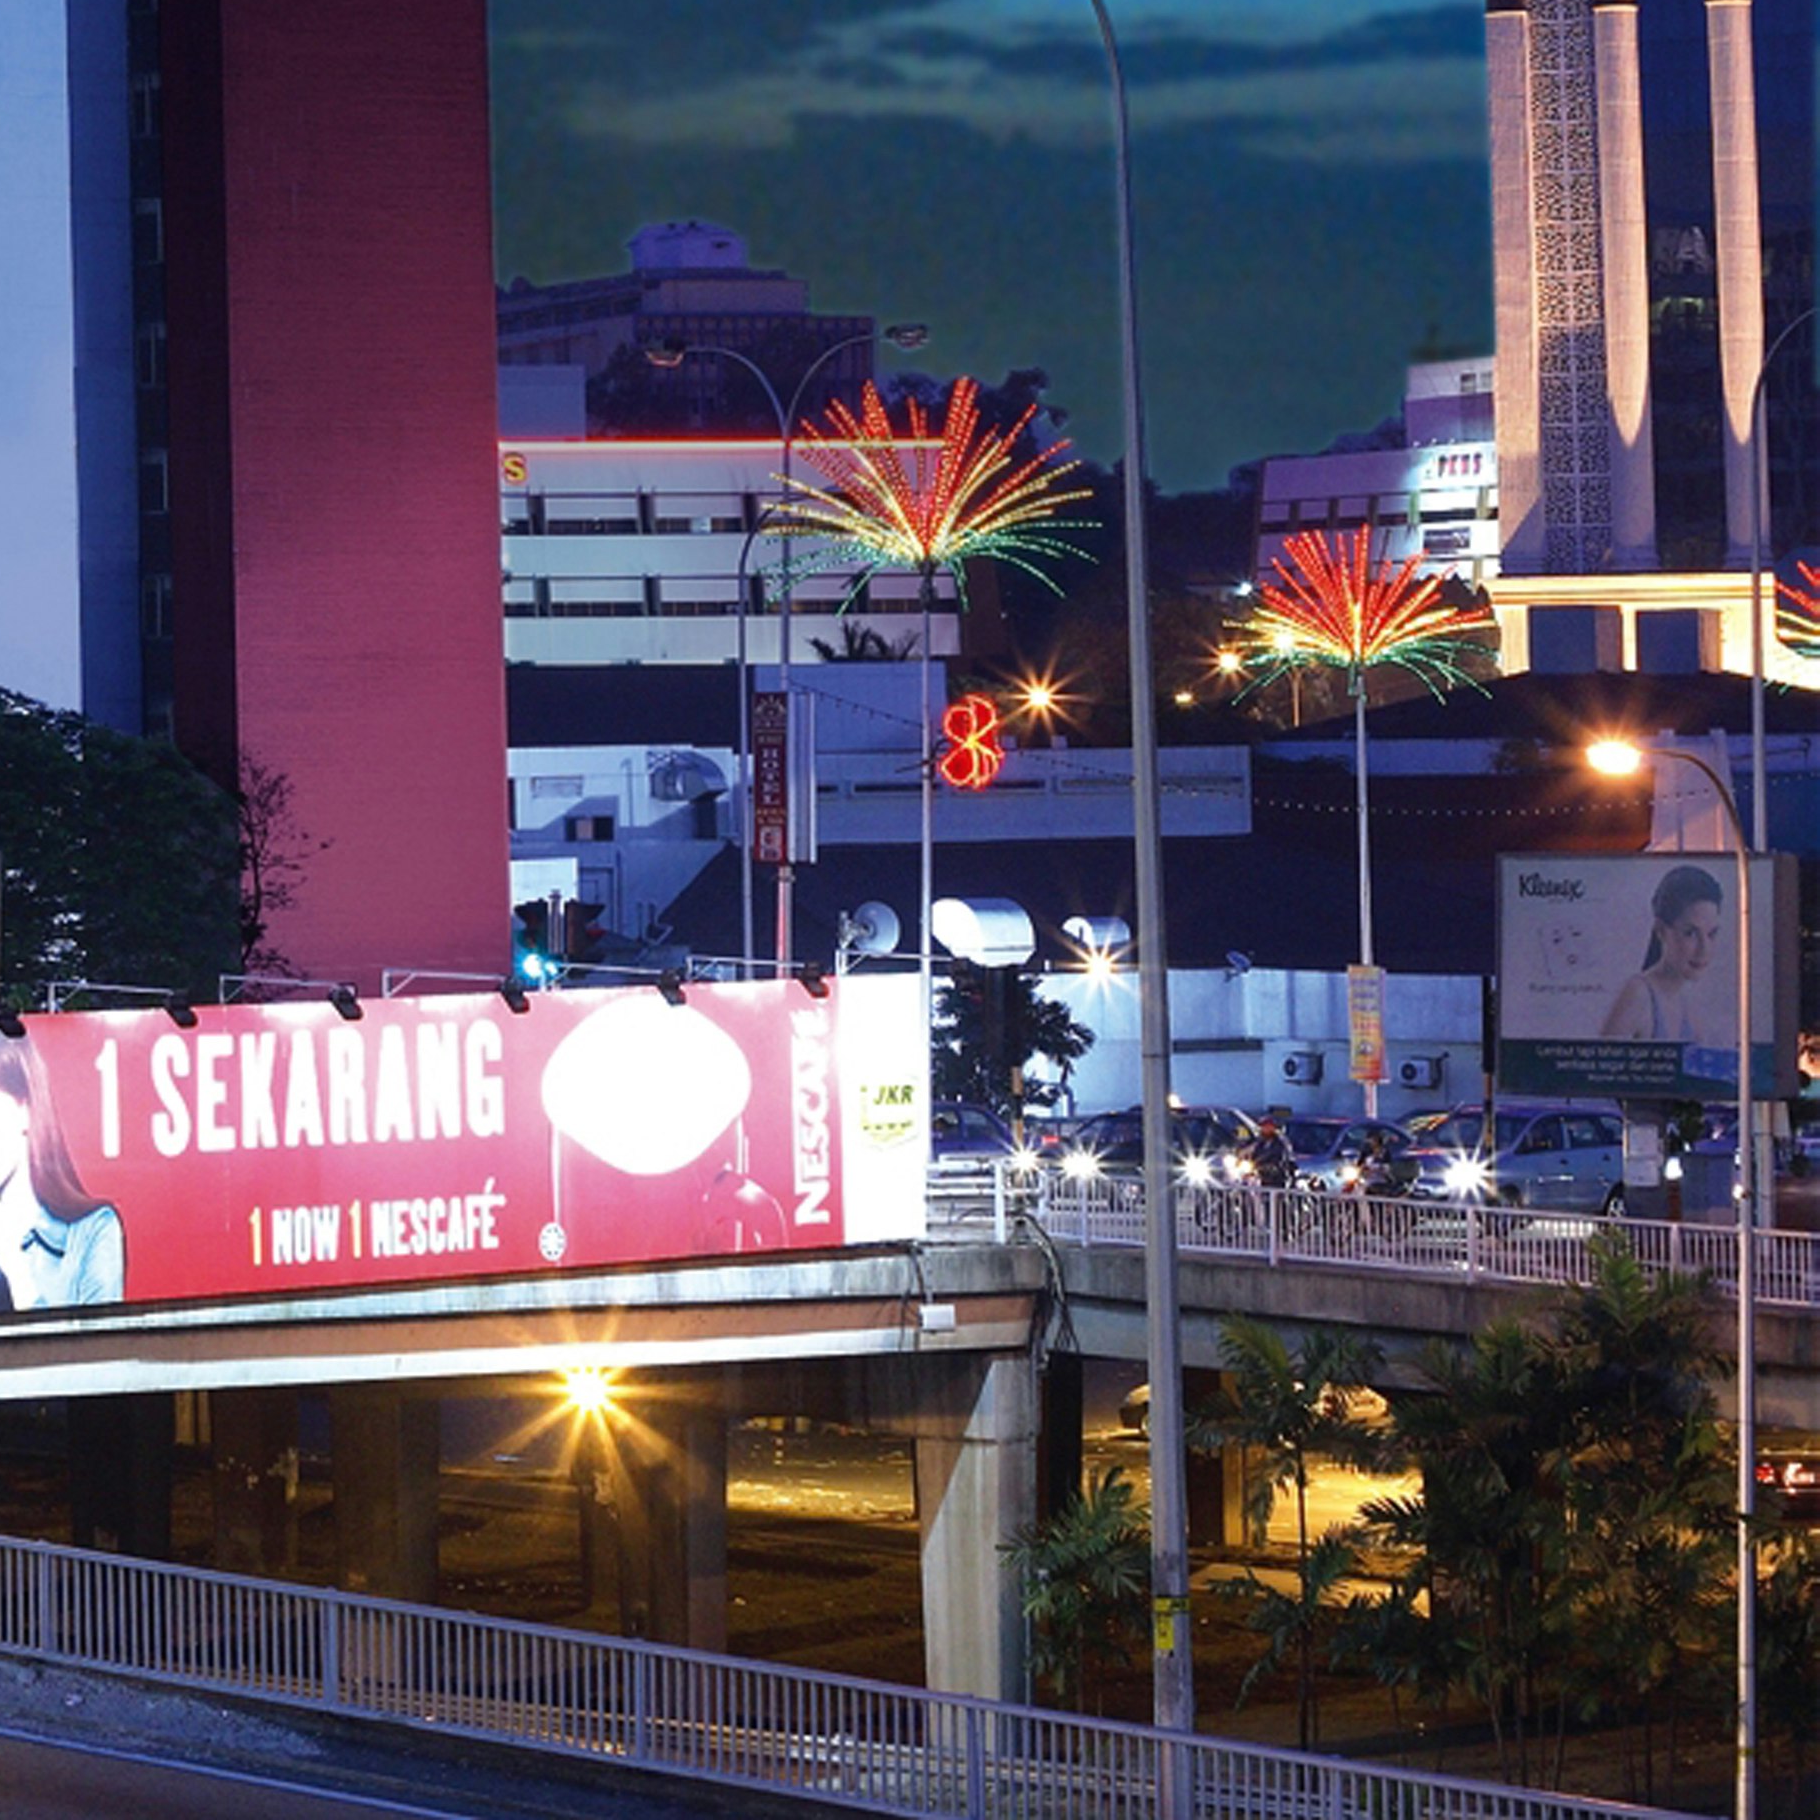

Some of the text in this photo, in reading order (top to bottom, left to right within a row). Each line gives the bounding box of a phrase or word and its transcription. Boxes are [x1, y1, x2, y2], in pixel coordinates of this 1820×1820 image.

[95, 1017, 506, 1159] 1 SEKARANG
[872, 1084, 915, 1105] JKR
[248, 1206, 263, 1266] 1
[272, 1204, 341, 1265] NOW
[348, 1199, 362, 1259] 1
